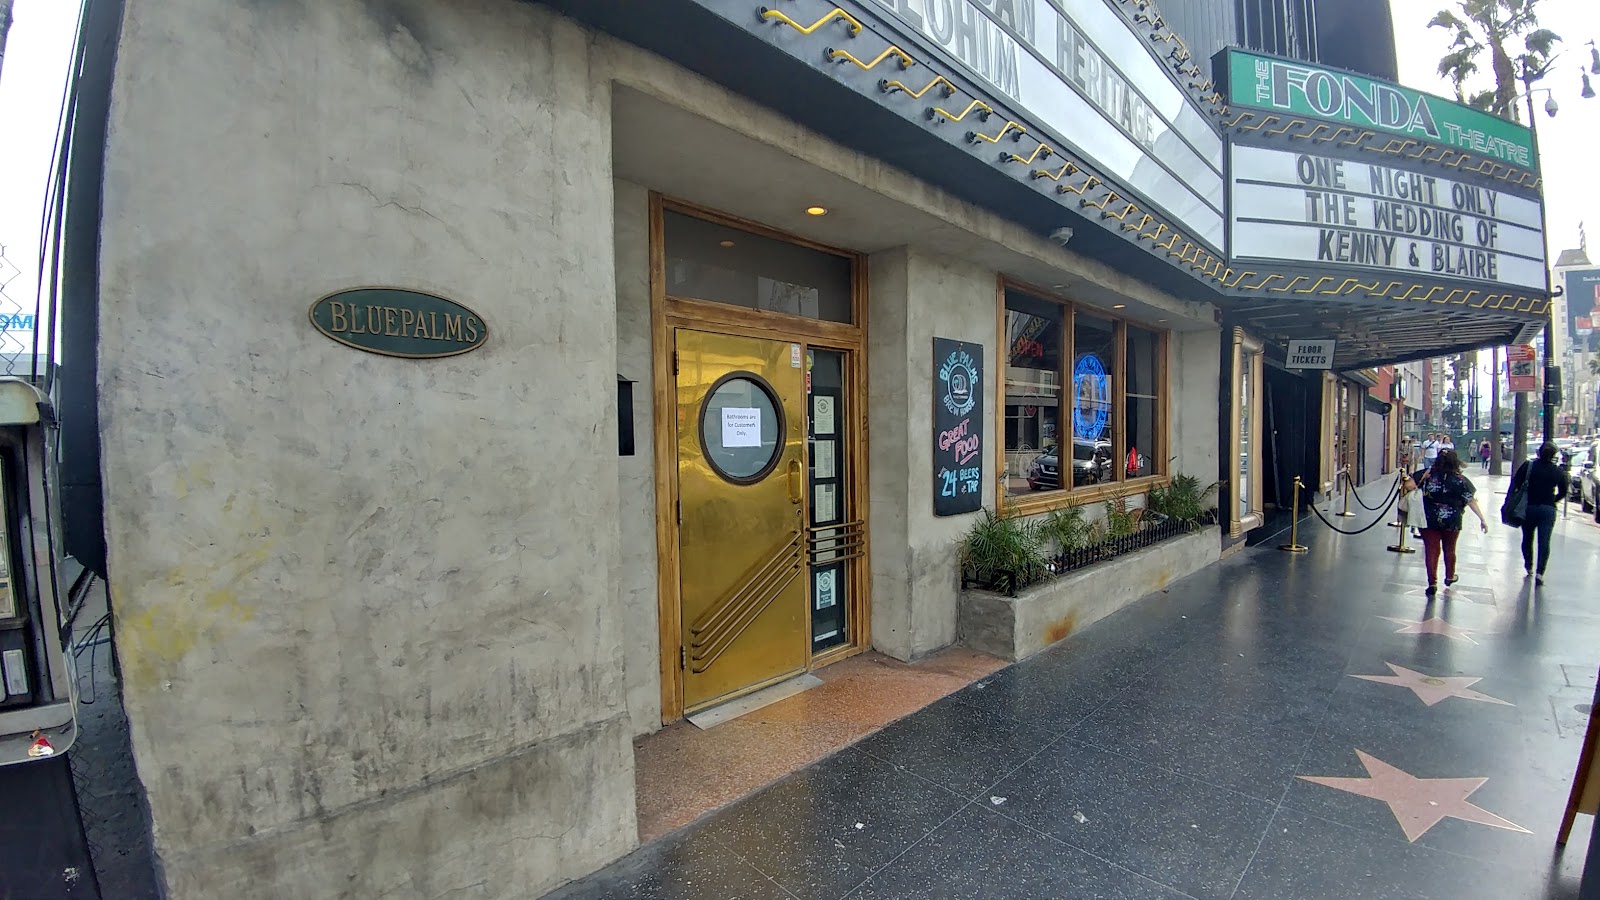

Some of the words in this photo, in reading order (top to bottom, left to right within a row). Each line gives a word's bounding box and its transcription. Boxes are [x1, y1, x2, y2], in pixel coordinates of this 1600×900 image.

[1056, 11, 1154, 153] HERITAGE
[1255, 59, 1269, 103] THE
[1271, 61, 1441, 140] FONDA
[1443, 121, 1530, 168] THEATRE
[1297, 153, 1347, 190] ONE
[1368, 164, 1436, 204] NIGHT
[1451, 181, 1498, 218] ONLY
[1305, 191, 1358, 227] THE
[1373, 199, 1464, 243] WEDDING
[1476, 219, 1498, 249] OF
[1317, 229, 1397, 267] KENNY
[1408, 241, 1420, 267] &
[1430, 242, 1498, 281] BLAIRE
[329, 300, 479, 344] BLUEPALMS
[1291, 355, 1328, 364] TICKETS
[1297, 345, 1323, 354] FLOOR
[939, 351, 959, 381] BLUE
[959, 350, 979, 385] PALMS
[943, 394, 960, 417] BREW
[938, 418, 970, 452] GREAT
[955, 433, 979, 463] FOOD
[941, 469, 958, 497] 24
[959, 467, 980, 481] BEERS
[966, 480, 979, 493] TAP
